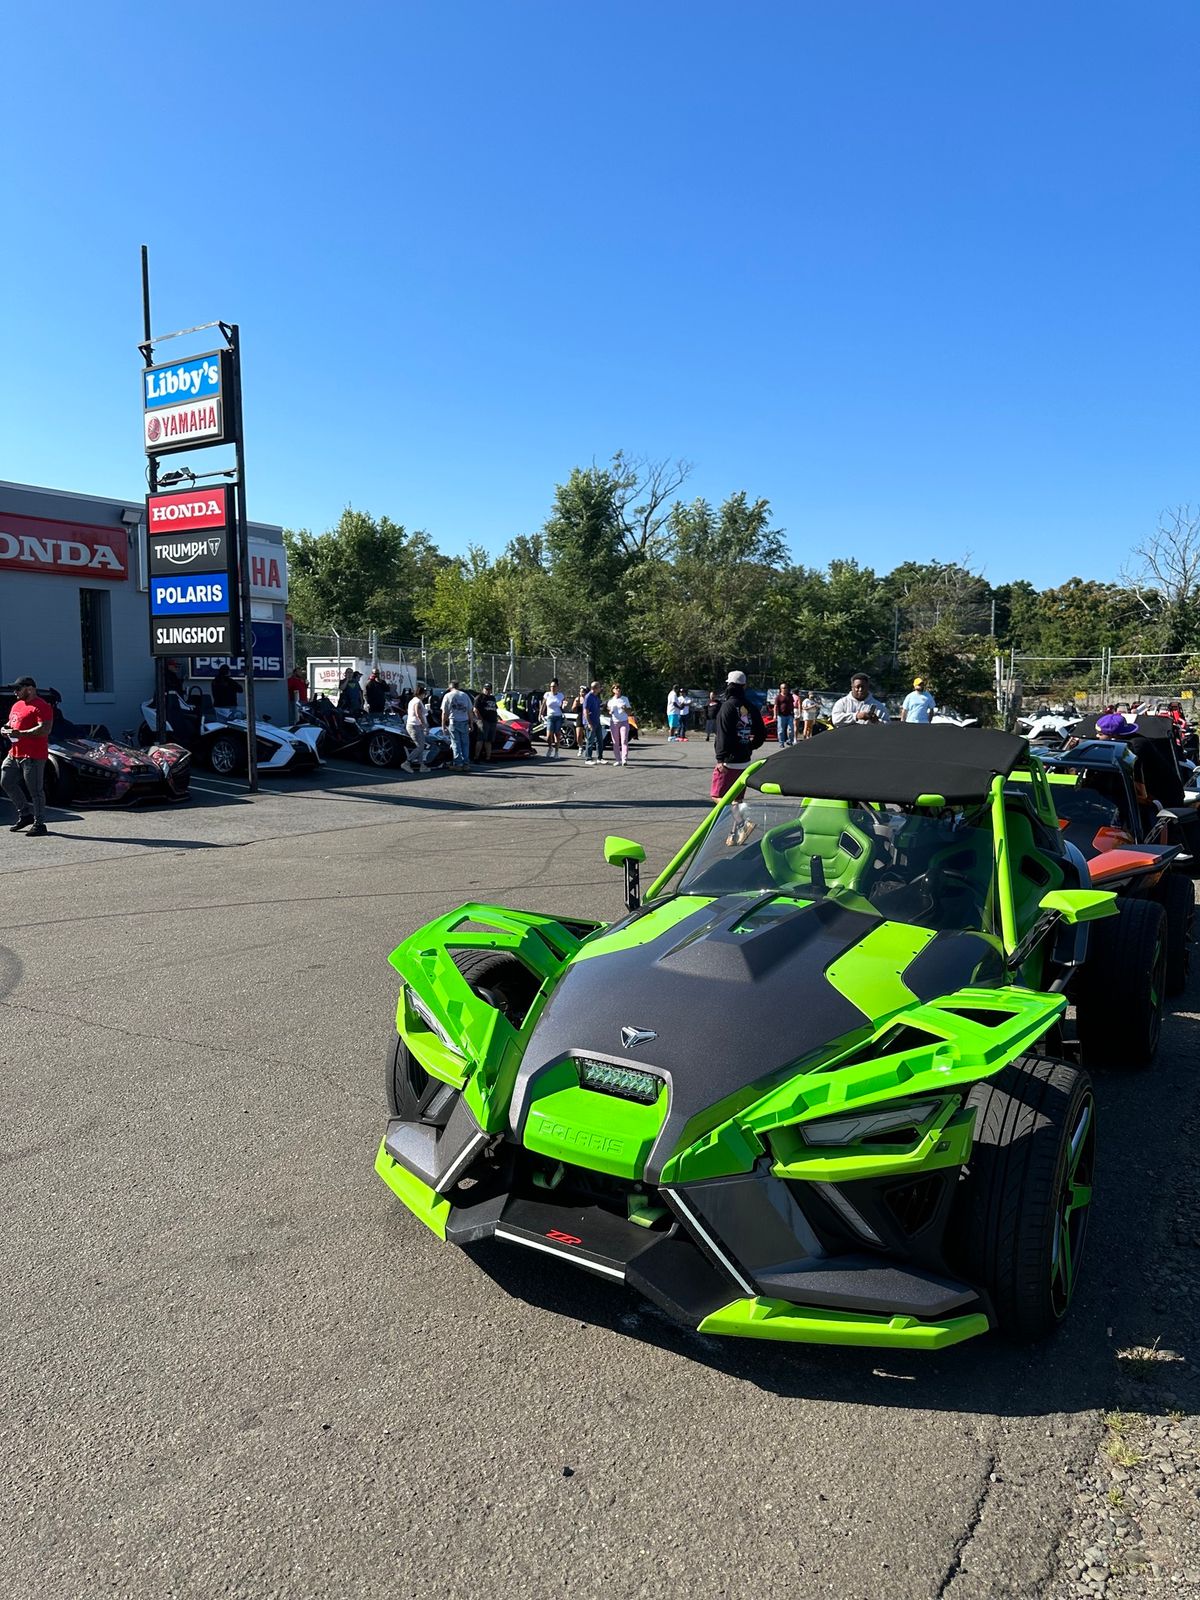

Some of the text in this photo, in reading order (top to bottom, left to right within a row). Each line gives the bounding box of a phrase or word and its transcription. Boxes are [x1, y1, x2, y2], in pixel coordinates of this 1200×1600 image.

[145, 361, 218, 399] Libby's
[161, 406, 217, 437] YAMAHA
[152, 501, 221, 521] HONDA
[0, 532, 124, 571] ONDA
[154, 541, 208, 564] TRIUMPH
[156, 584, 223, 605] POLARIS
[156, 626, 226, 645] SLINGSHOT
[538, 1119, 625, 1154] POLARIS
